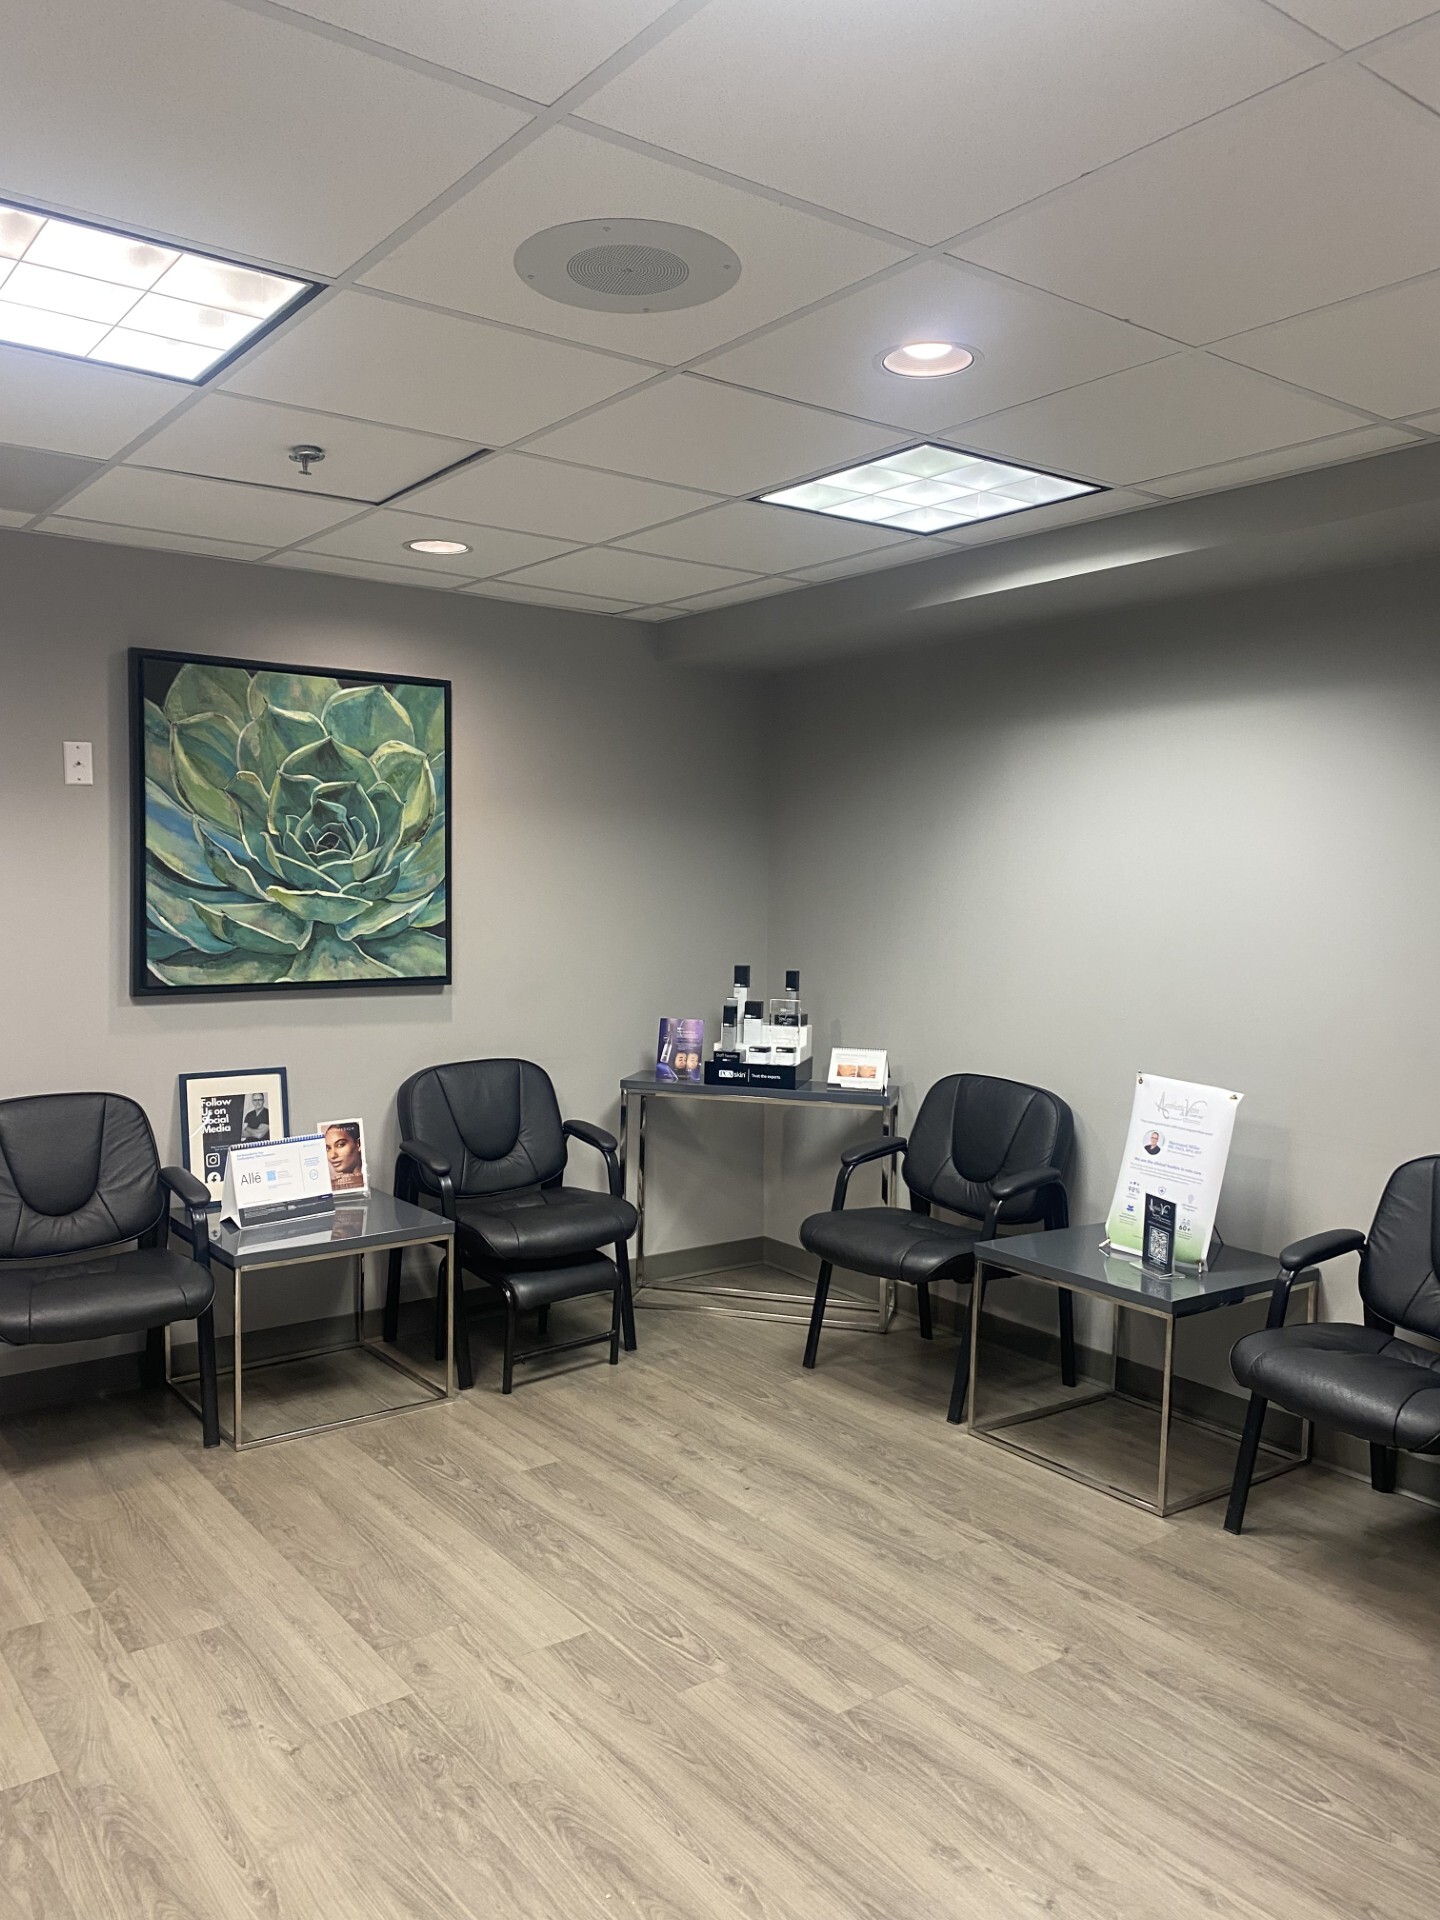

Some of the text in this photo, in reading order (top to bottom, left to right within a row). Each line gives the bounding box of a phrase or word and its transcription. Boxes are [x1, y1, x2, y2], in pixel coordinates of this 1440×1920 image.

[201, 1098, 231, 1107] Follow
[202, 1107, 213, 1116] Us
[202, 1113, 229, 1125] Social
[203, 1123, 231, 1134] Media
[240, 1171, 262, 1186] Allé
